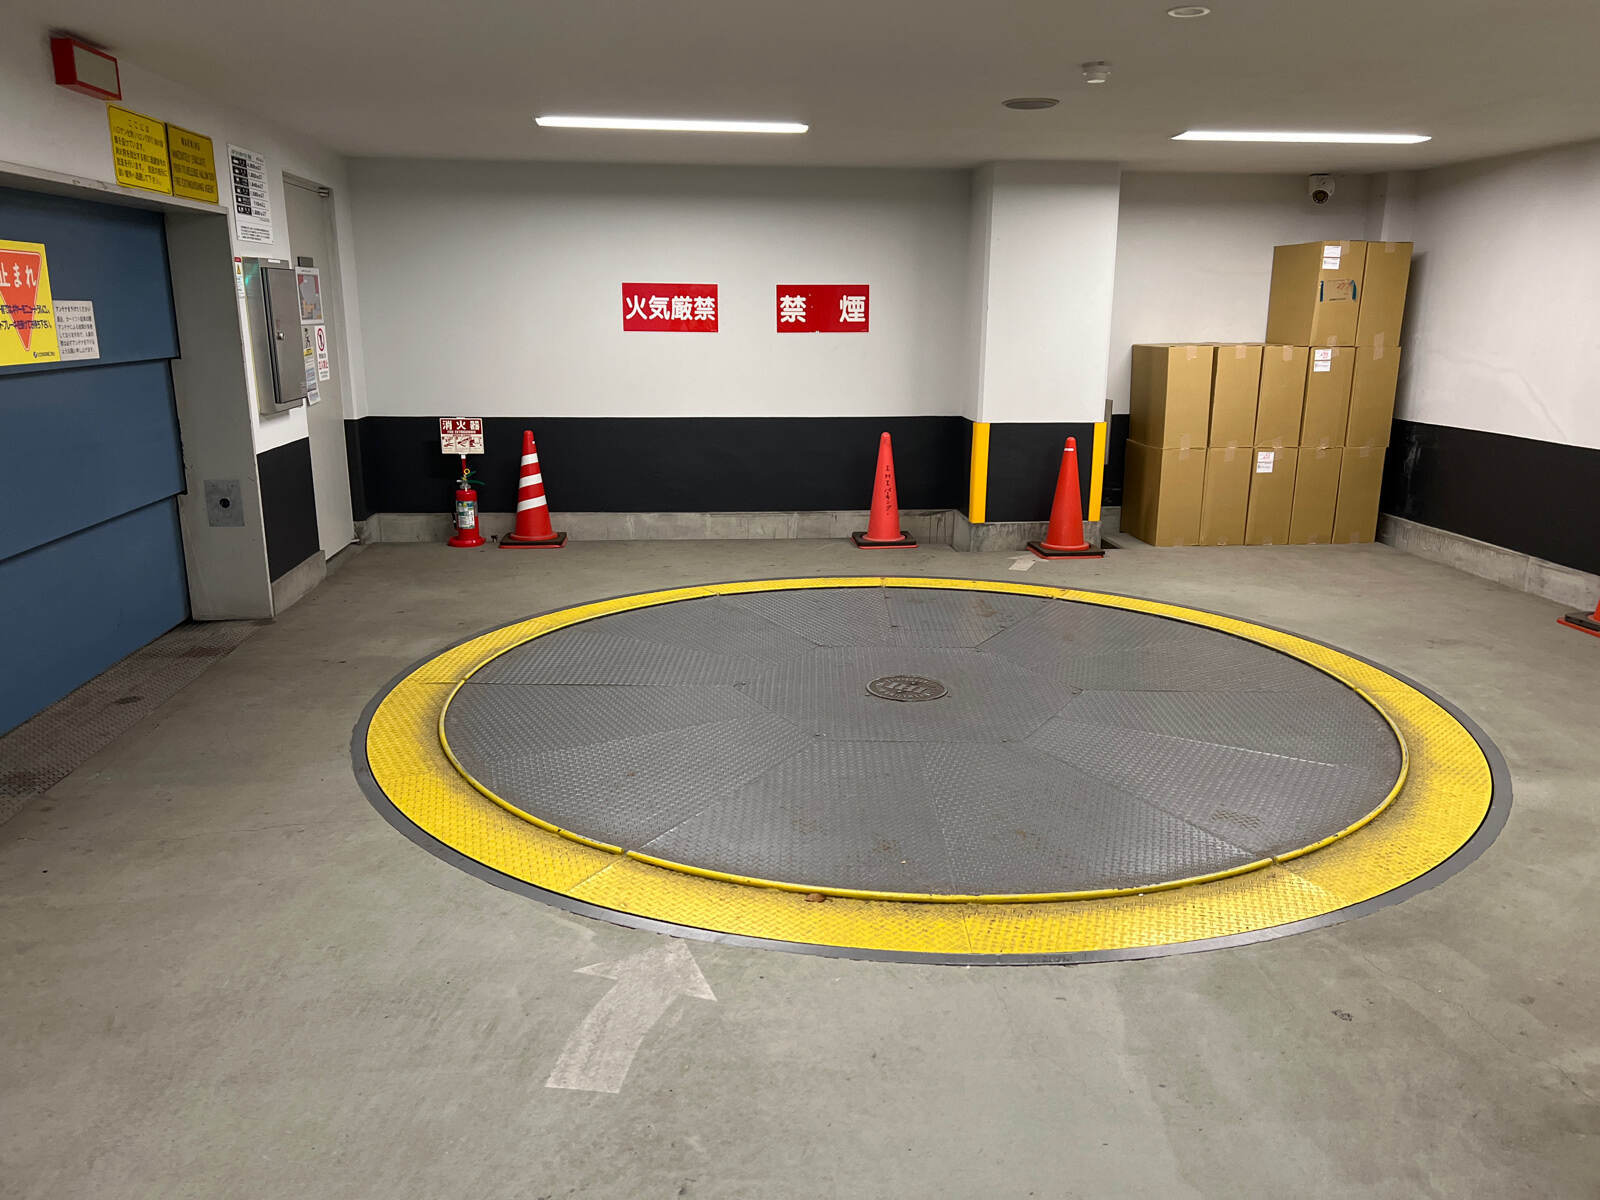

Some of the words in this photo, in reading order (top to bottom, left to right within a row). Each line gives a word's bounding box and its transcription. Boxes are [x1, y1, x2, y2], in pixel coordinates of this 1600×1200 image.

[0, 262, 37, 288] 止まれ
[625, 294, 716, 321] 火気厳禁
[442, 420, 480, 431] 消火器
